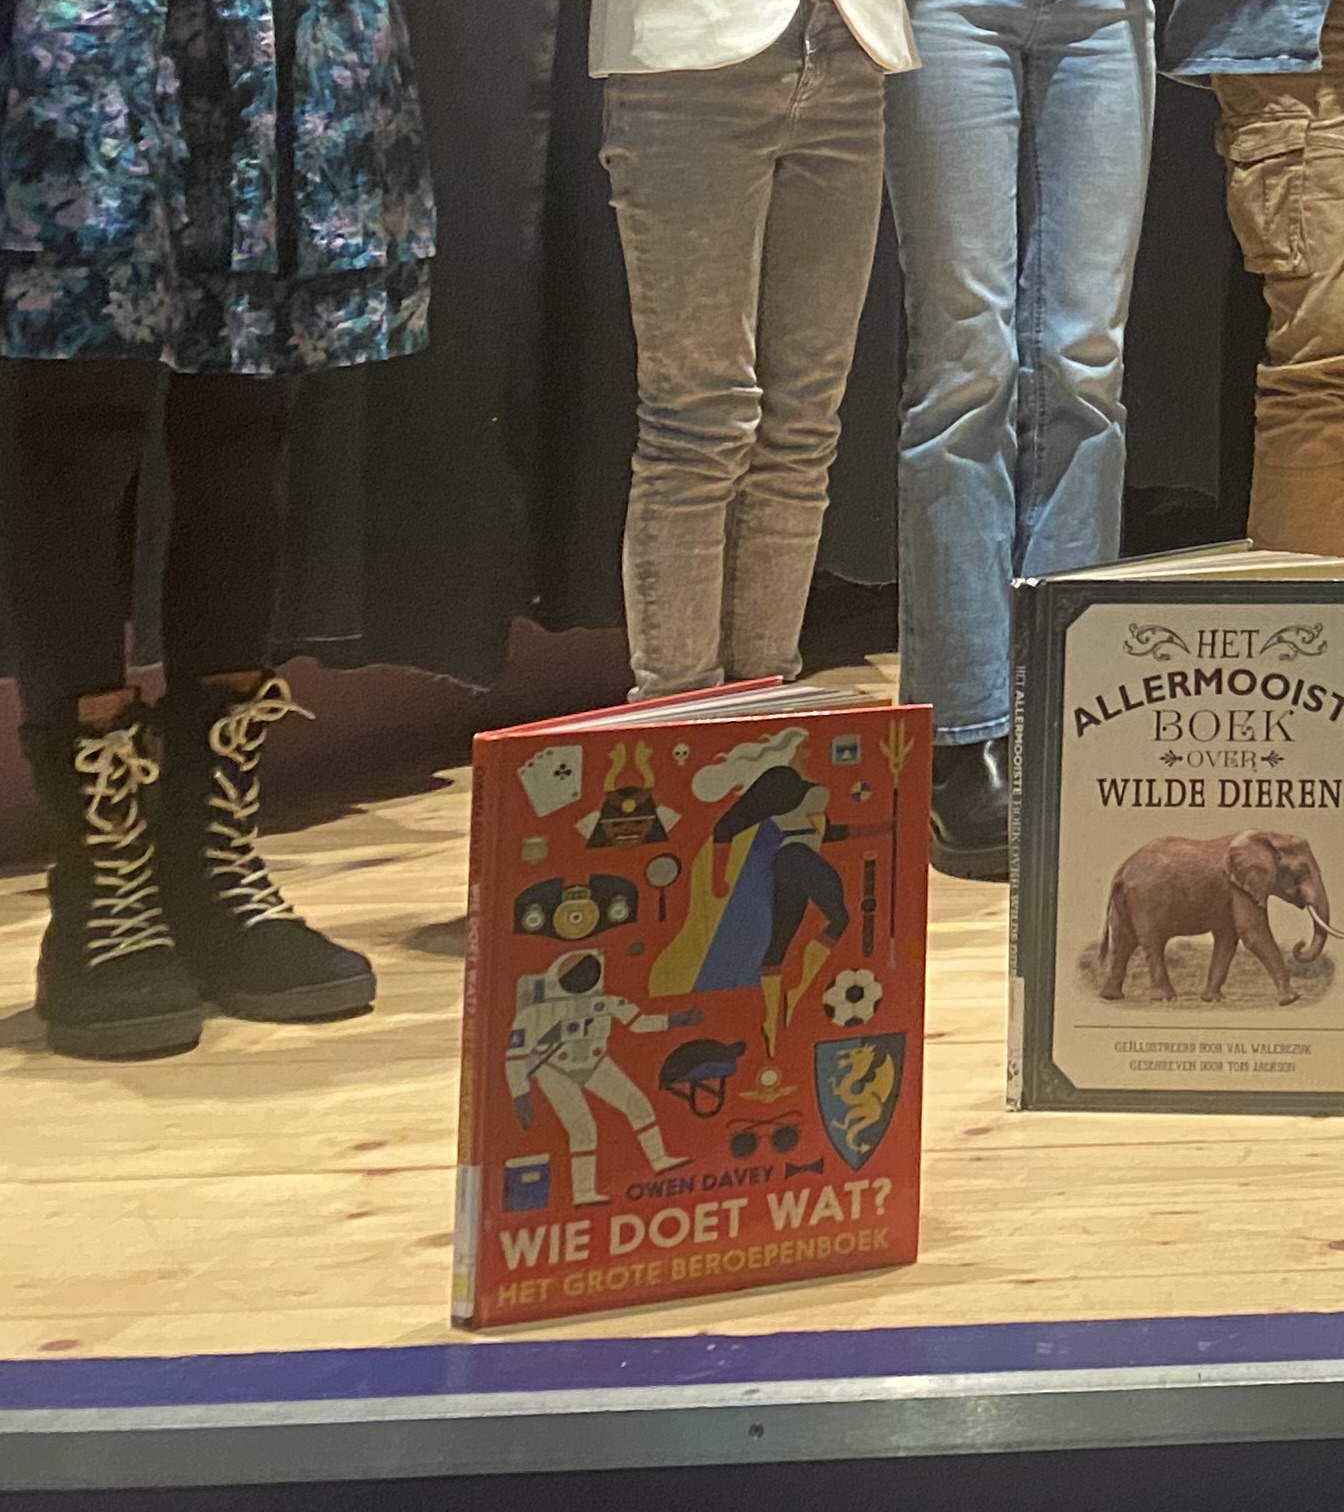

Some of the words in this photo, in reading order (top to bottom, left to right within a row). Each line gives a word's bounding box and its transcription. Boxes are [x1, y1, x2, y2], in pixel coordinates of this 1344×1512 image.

[1197, 629, 1259, 659] HET
[1152, 709, 1297, 743] BOEK
[1012, 690, 1025, 796] ALLERMOOISTE
[1186, 749, 1258, 772] OVER
[1097, 778, 1206, 808] WILDE
[1217, 778, 1343, 809] DIEREN
[1226, 1042, 1248, 1055] VAL
[1227, 1061, 1249, 1072] TOM
[625, 1175, 696, 1201] OWEN
[701, 1165, 774, 1191] DAVEY
[500, 1220, 590, 1271] WIE
[609, 1197, 748, 1256] DOET
[767, 1177, 893, 1231] WAT?
[497, 1277, 552, 1307] HET
[563, 1260, 663, 1296] GROTE
[671, 1228, 889, 1280] BEROEPENBOEK
